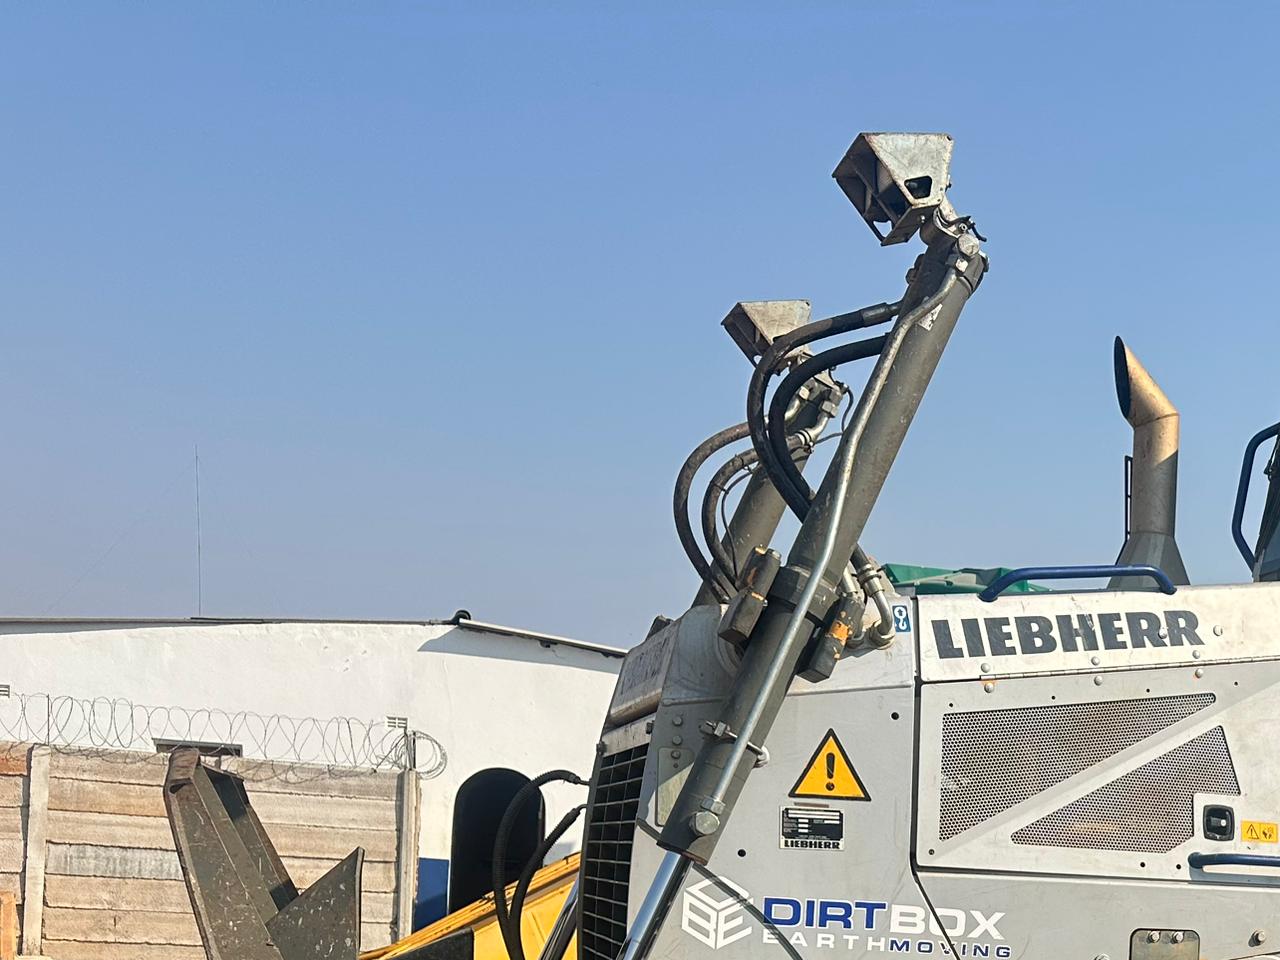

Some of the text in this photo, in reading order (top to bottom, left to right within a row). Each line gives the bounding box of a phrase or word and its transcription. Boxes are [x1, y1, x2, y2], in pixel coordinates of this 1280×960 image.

[931, 610, 1205, 659] LIEBHERR
[784, 839, 840, 849] LIEBHERR
[762, 930, 1012, 960] EARTHMOVING
